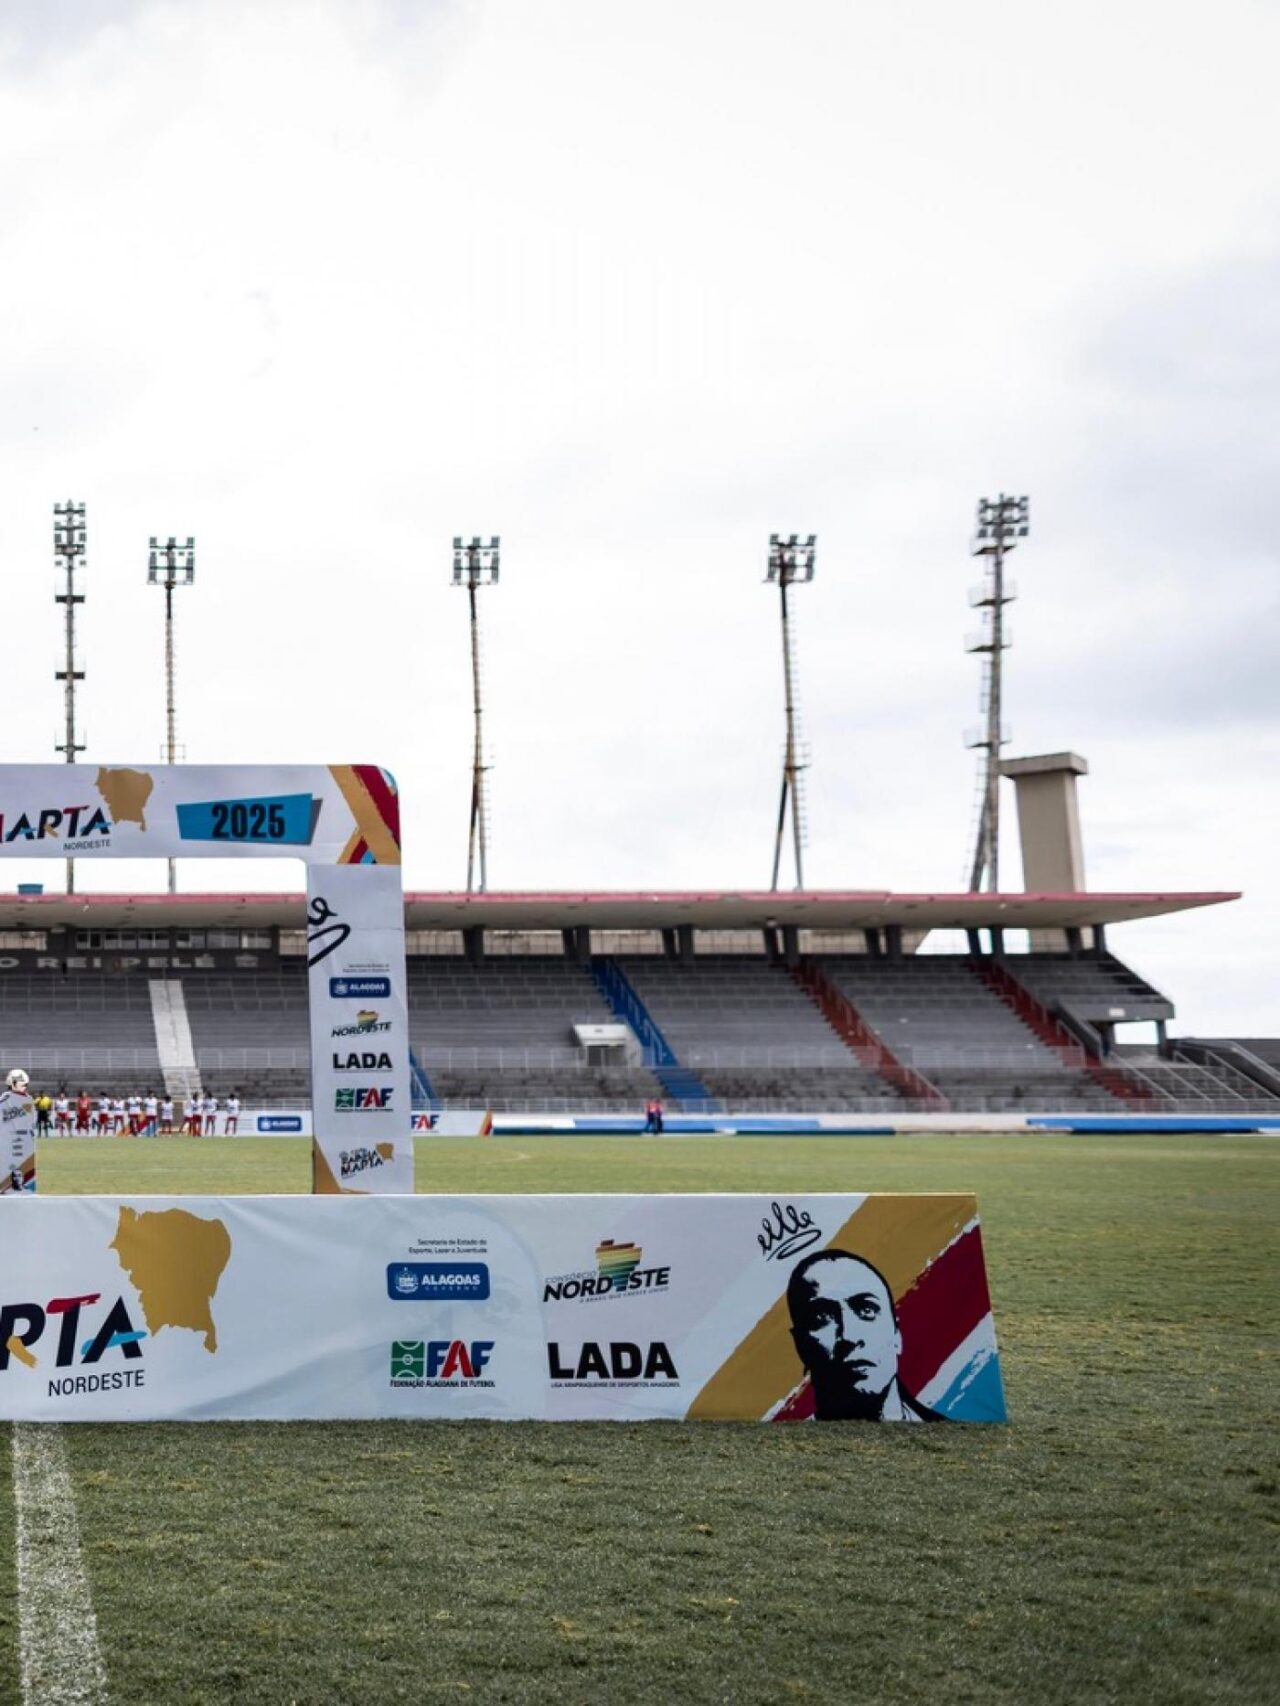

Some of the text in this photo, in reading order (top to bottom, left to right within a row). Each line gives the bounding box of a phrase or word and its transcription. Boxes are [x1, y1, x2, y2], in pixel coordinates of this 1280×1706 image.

[211, 803, 285, 838] 2025
[63, 839, 112, 851] NORDESTE
[37, 956, 101, 969] REI
[121, 953, 215, 969] PELÉ
[333, 1052, 393, 1069] LADA
[355, 1087, 394, 1108] FAF
[410, 1113, 440, 1130] FAF
[421, 1273, 481, 1286] ALAGOAS
[426, 1339, 496, 1378] FAF
[546, 1341, 679, 1380] LADA
[47, 1369, 146, 1397] NORDESTE
